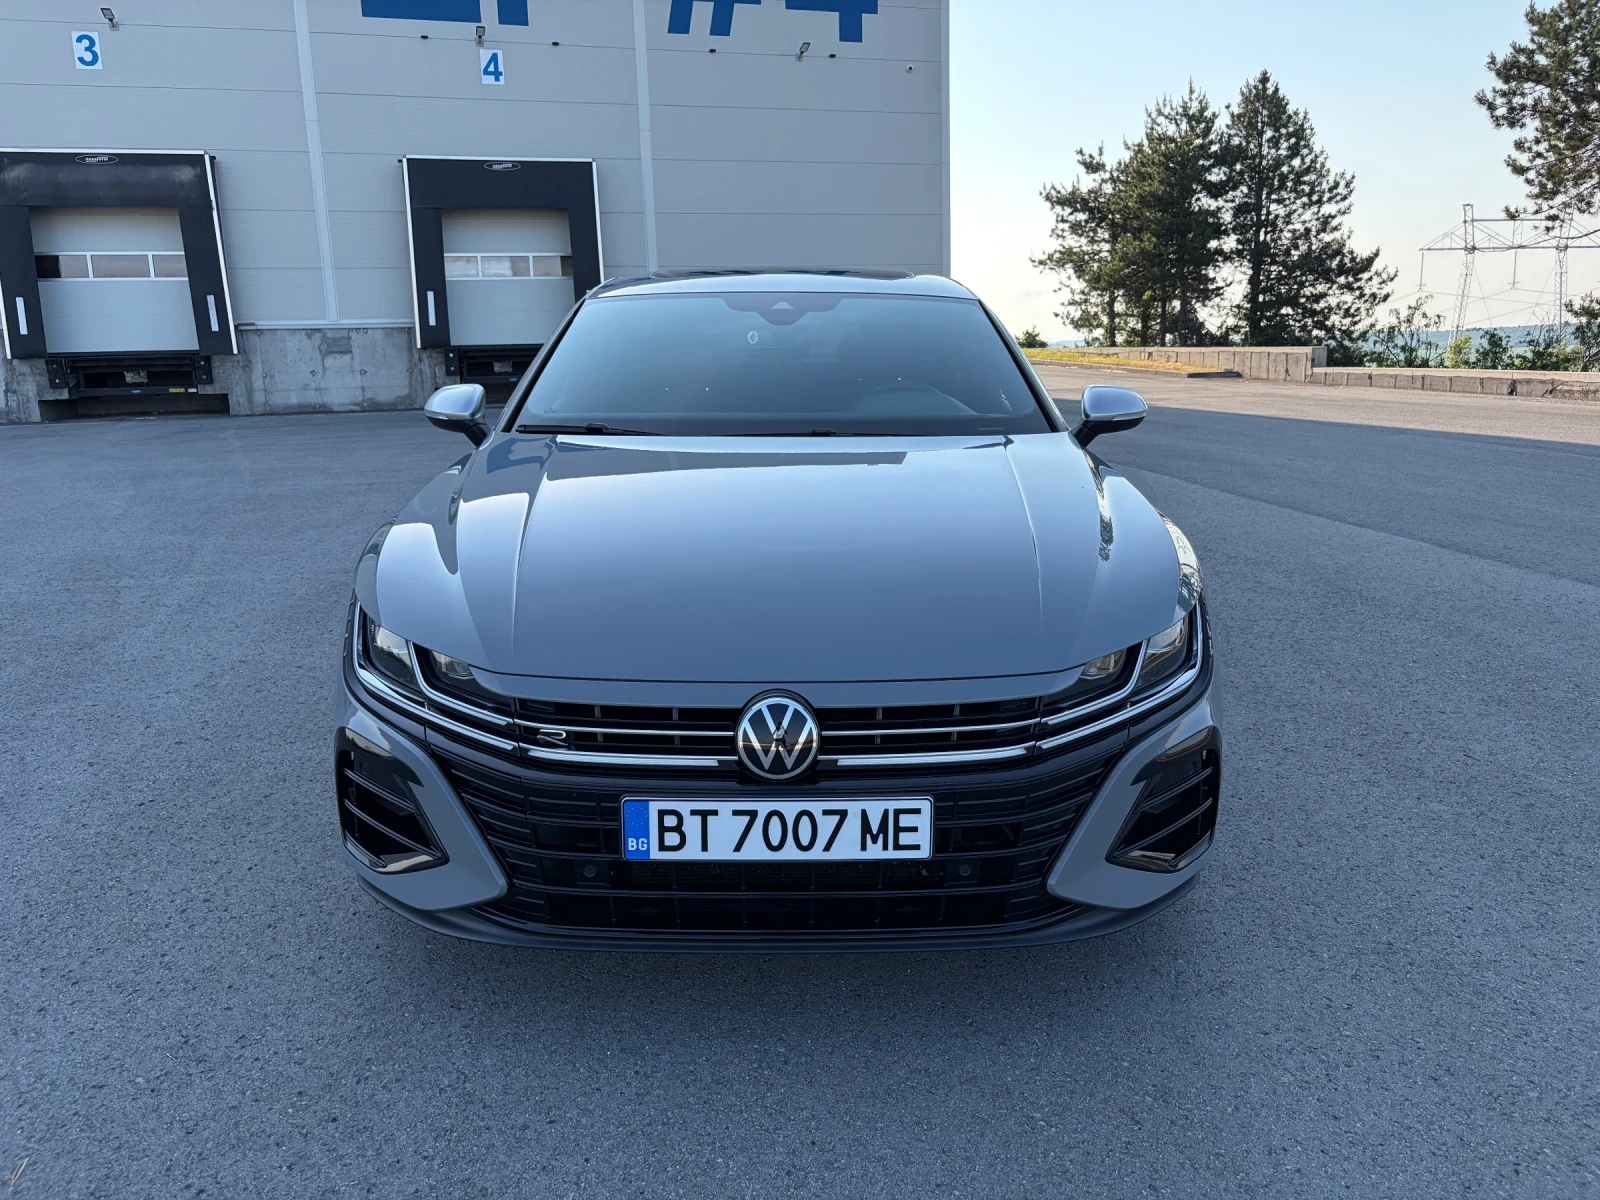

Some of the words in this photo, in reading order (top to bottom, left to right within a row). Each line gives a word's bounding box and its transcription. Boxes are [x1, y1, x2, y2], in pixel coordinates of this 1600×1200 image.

[76, 34, 99, 66] 3
[483, 52, 503, 82] 4
[628, 838, 648, 851] BG
[657, 808, 719, 852] BT
[731, 808, 848, 852] 7007
[860, 807, 922, 852] ME
